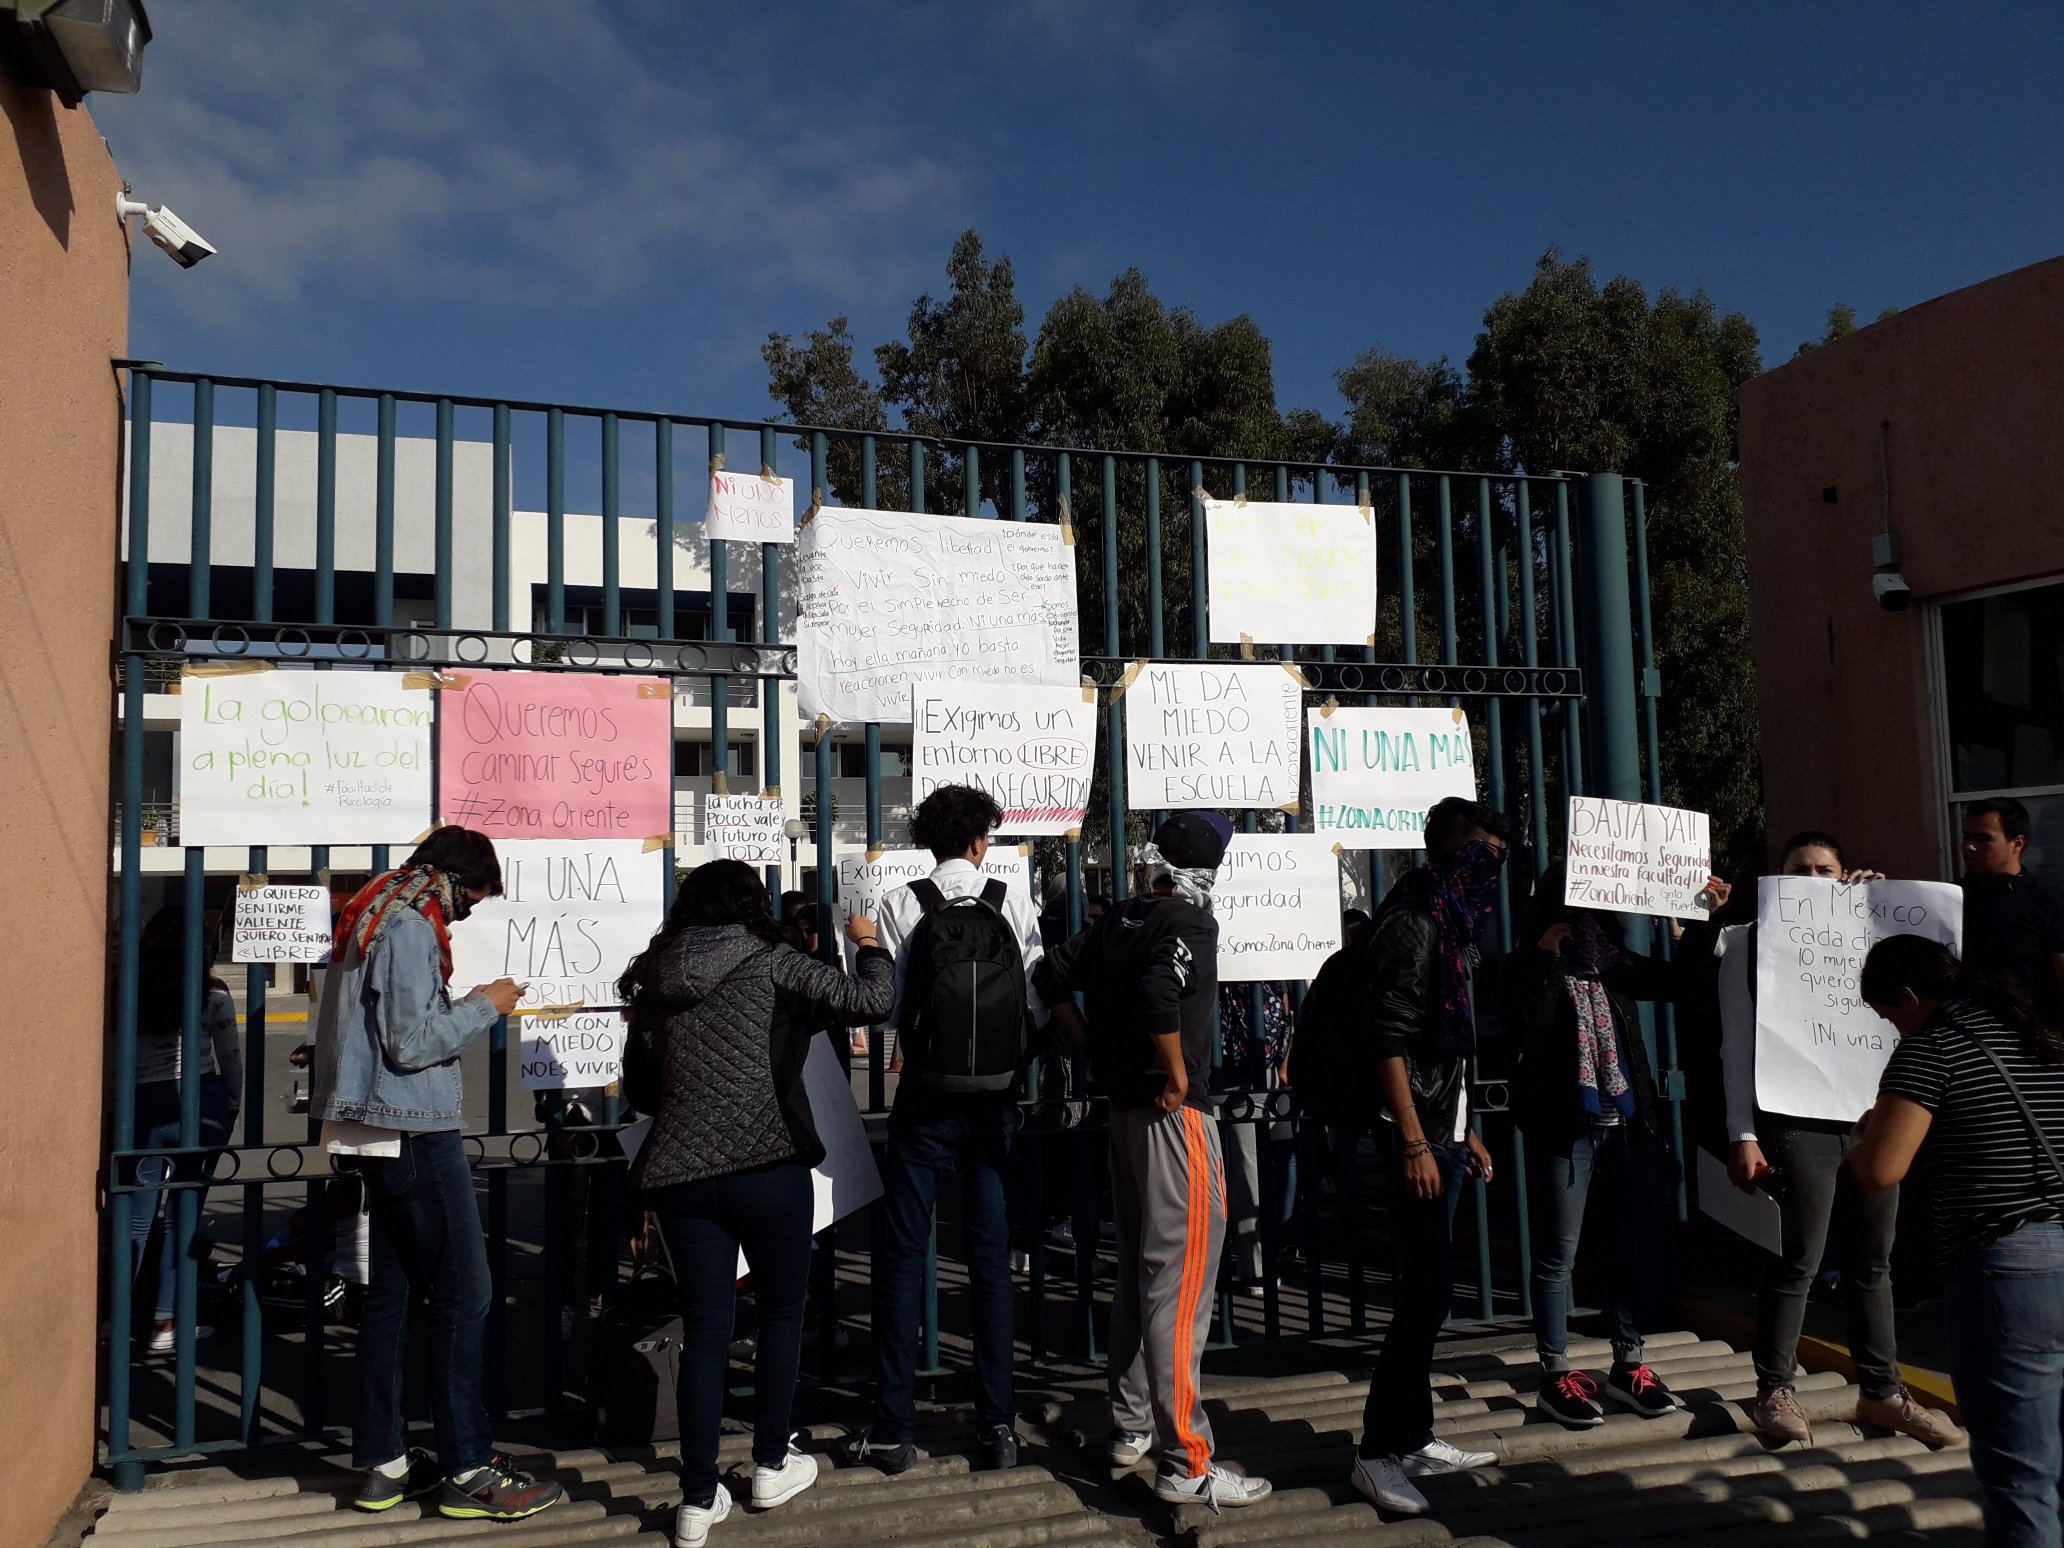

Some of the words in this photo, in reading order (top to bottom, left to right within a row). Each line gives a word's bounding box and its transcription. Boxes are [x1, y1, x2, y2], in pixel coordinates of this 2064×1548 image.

[858, 600, 875, 614] el
[976, 593, 993, 606] de
[865, 649, 889, 665] ella
[896, 644, 947, 661] mañana
[978, 636, 1019, 653] basta
[1004, 664, 1017, 674] no
[1020, 662, 1035, 674] es
[1150, 670, 1183, 704] ME
[1200, 671, 1247, 702] DA
[204, 684, 242, 725] La
[260, 683, 433, 745] golpearon
[464, 683, 618, 744] Queremos
[1035, 709, 1074, 730] un
[1163, 706, 1250, 737] MIEDO
[192, 750, 214, 771] a
[229, 737, 311, 781] plena
[326, 741, 366, 770] luz
[374, 740, 419, 771] del
[1023, 744, 1085, 765] LIBRE
[1133, 743, 1208, 770] VENIR
[1219, 741, 1234, 765] A
[1249, 740, 1282, 766] LA
[1313, 726, 1348, 772] NI
[1363, 729, 1420, 772] UNA
[246, 768, 310, 807] día!
[1164, 774, 1275, 803] ESCUELA
[553, 800, 630, 829] Oriente
[725, 797, 763, 811] lucha
[754, 811, 780, 827] vale
[1571, 798, 1648, 842] BASTA
[706, 828, 717, 842] el
[722, 827, 767, 844] futuro
[1221, 847, 1297, 882] gimos
[1569, 839, 1649, 865] Necesitamos
[545, 853, 628, 903] UNA
[840, 859, 926, 886] Exigimos
[1591, 864, 1629, 878] nuestra
[263, 888, 320, 900] QUIERO
[1213, 888, 1302, 920] eguridad
[1778, 878, 1814, 923] En
[1830, 884, 1927, 926] México
[237, 903, 306, 914] SENTIRME
[236, 931, 286, 943] QUIERO
[501, 912, 602, 978] MÁS
[1788, 923, 1843, 948] cada
[1799, 948, 1815, 967] 10
[1800, 970, 1856, 993] quiero
[575, 1016, 611, 1030] CON
[535, 1033, 614, 1053] MIEDO
[1847, 1034, 1883, 1050] una
[575, 1061, 619, 1076] VIVIR
